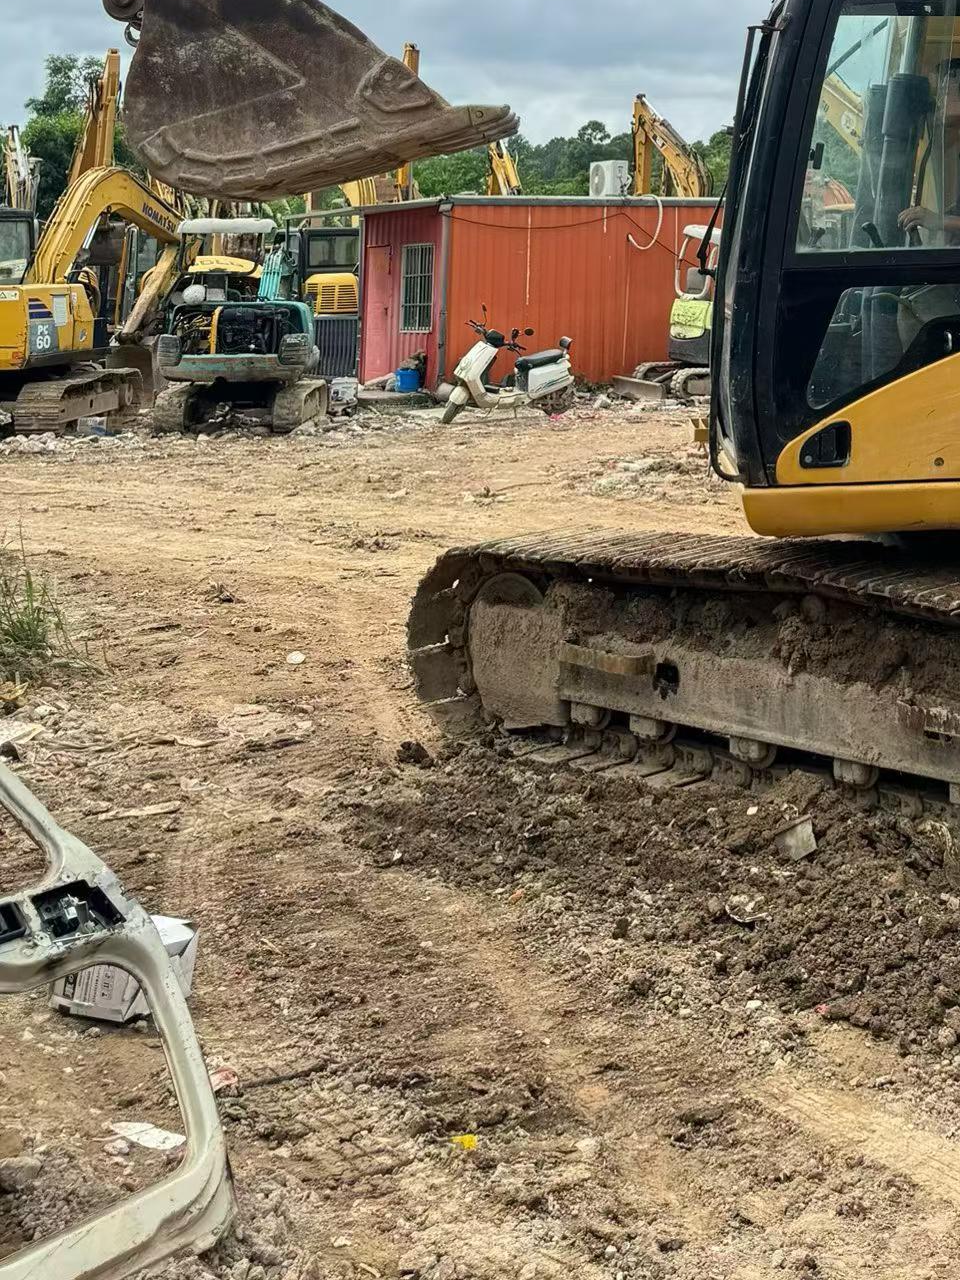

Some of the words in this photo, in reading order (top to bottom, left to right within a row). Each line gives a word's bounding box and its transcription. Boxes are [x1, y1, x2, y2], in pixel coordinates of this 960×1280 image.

[142, 202, 176, 233] KOMATSU
[37, 324, 49, 336] PC
[36, 334, 51, 349] 60
